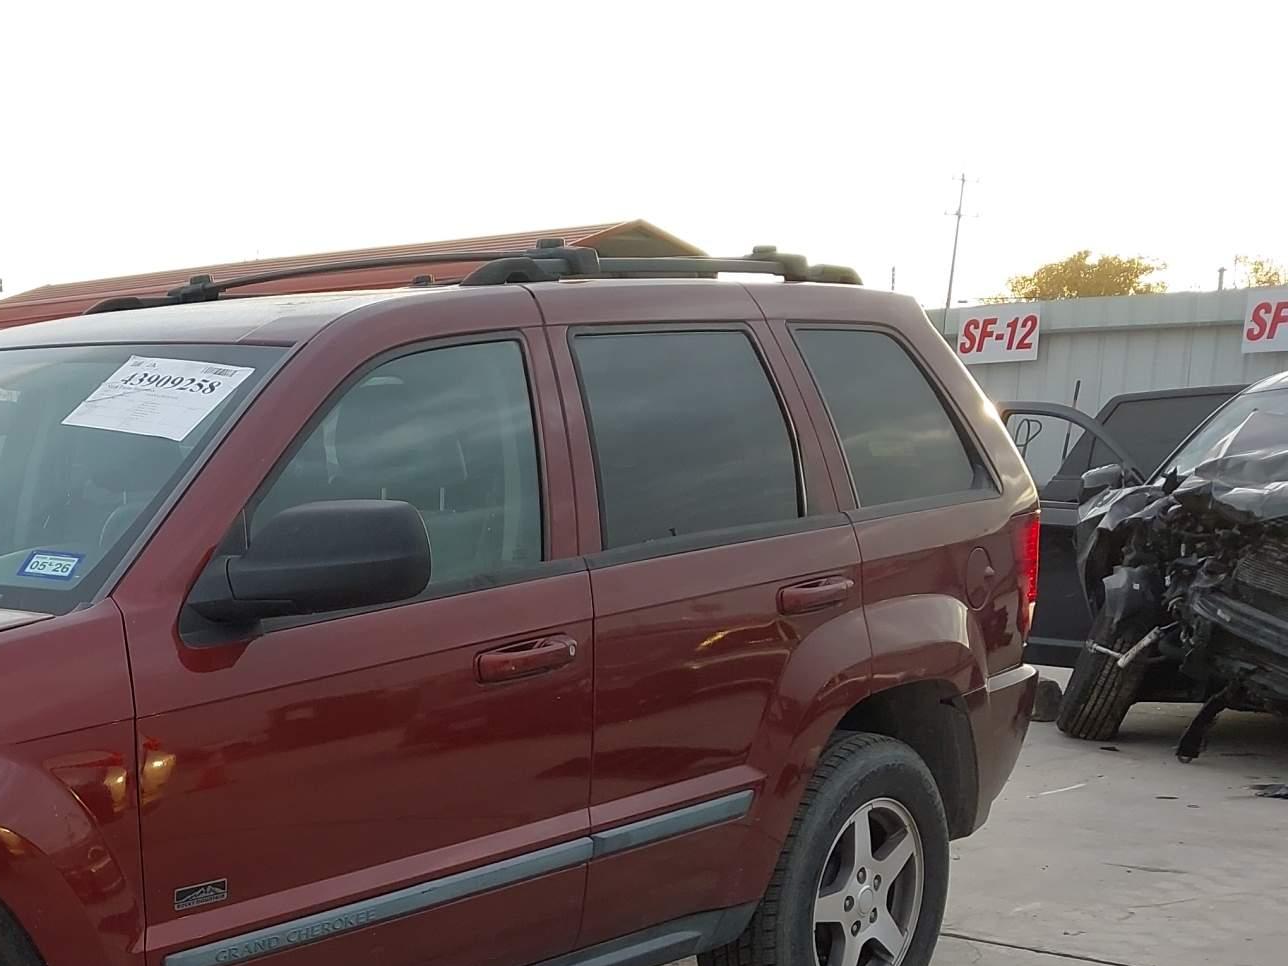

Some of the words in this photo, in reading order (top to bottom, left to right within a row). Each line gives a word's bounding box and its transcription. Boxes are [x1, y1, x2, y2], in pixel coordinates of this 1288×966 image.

[959, 314, 1038, 354] SF-12
[121, 372, 222, 395] 43909258
[29, 560, 48, 571] 05
[52, 562, 72, 574] 26
[215, 936, 280, 963] GRAND
[285, 907, 377, 944] CHEROKEE
